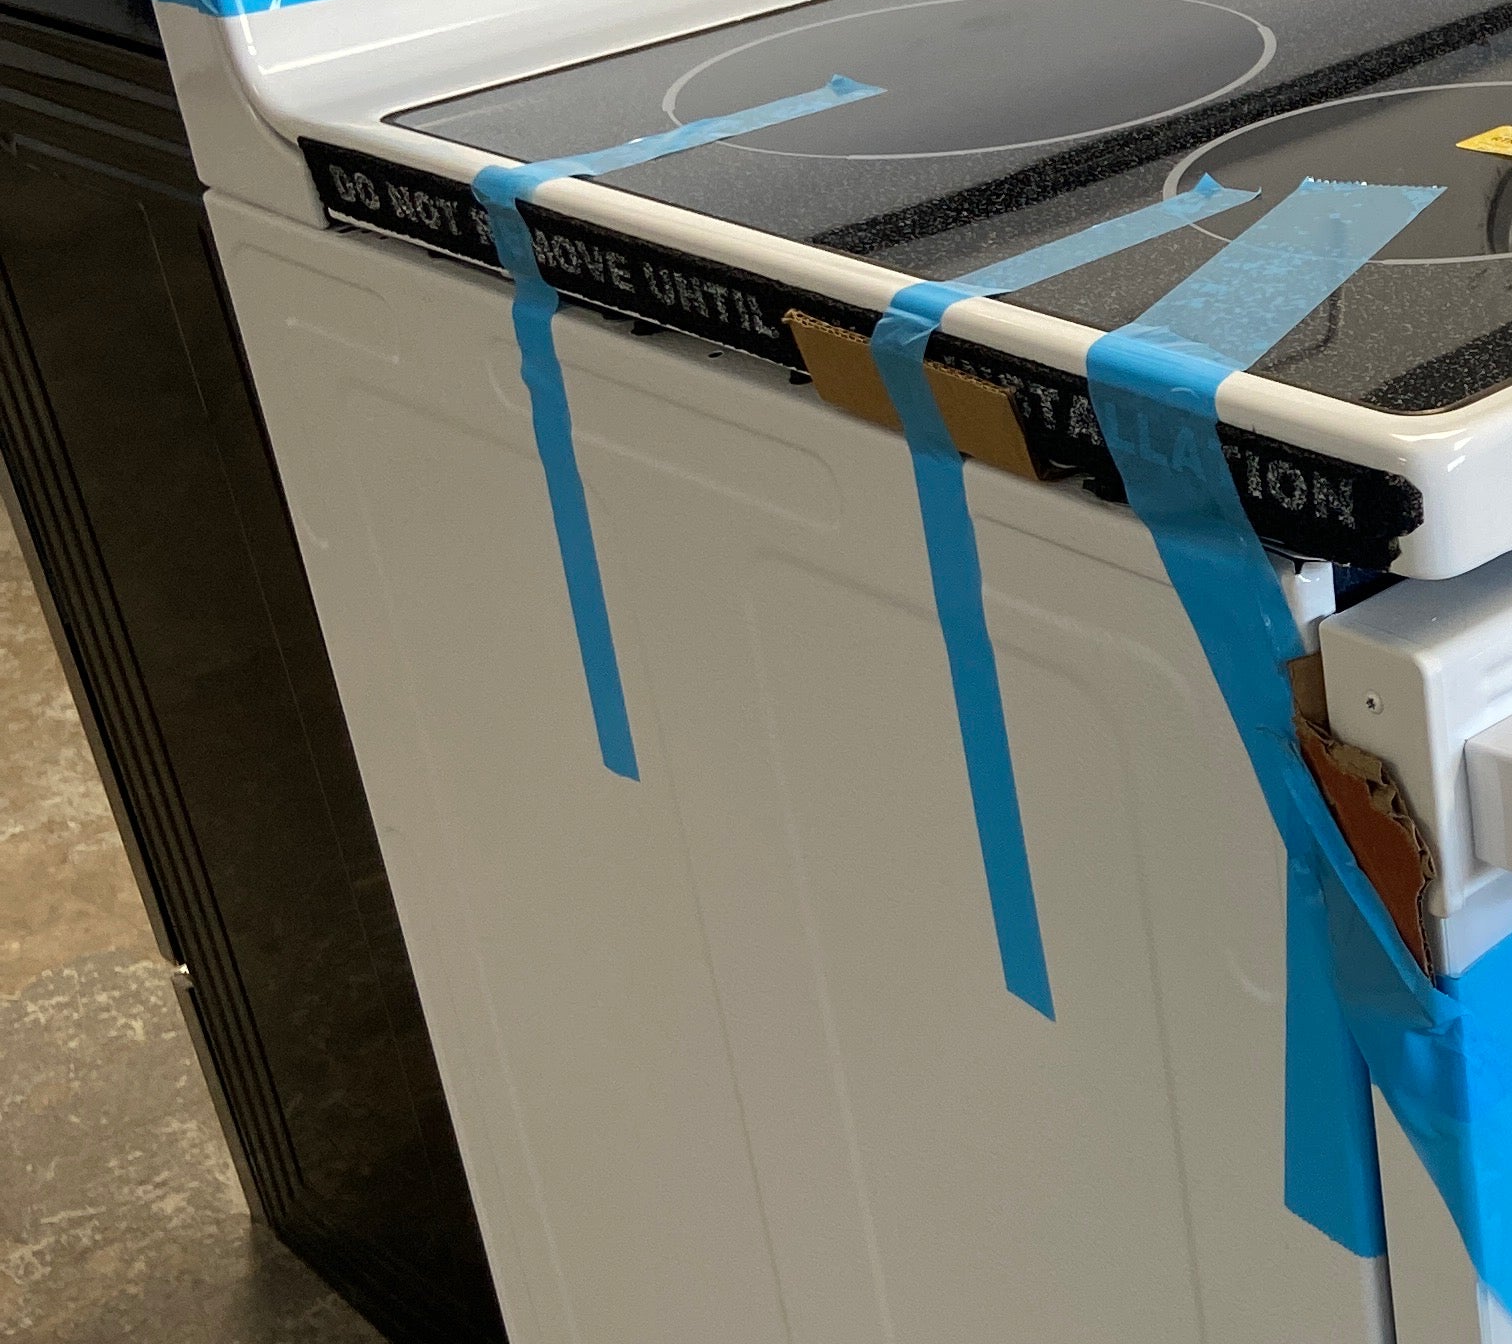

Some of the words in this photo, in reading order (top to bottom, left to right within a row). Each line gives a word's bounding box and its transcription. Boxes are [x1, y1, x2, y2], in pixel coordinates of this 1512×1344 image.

[329, 164, 381, 211] DO
[385, 184, 462, 238] NOT
[643, 261, 779, 340] UNTIL
